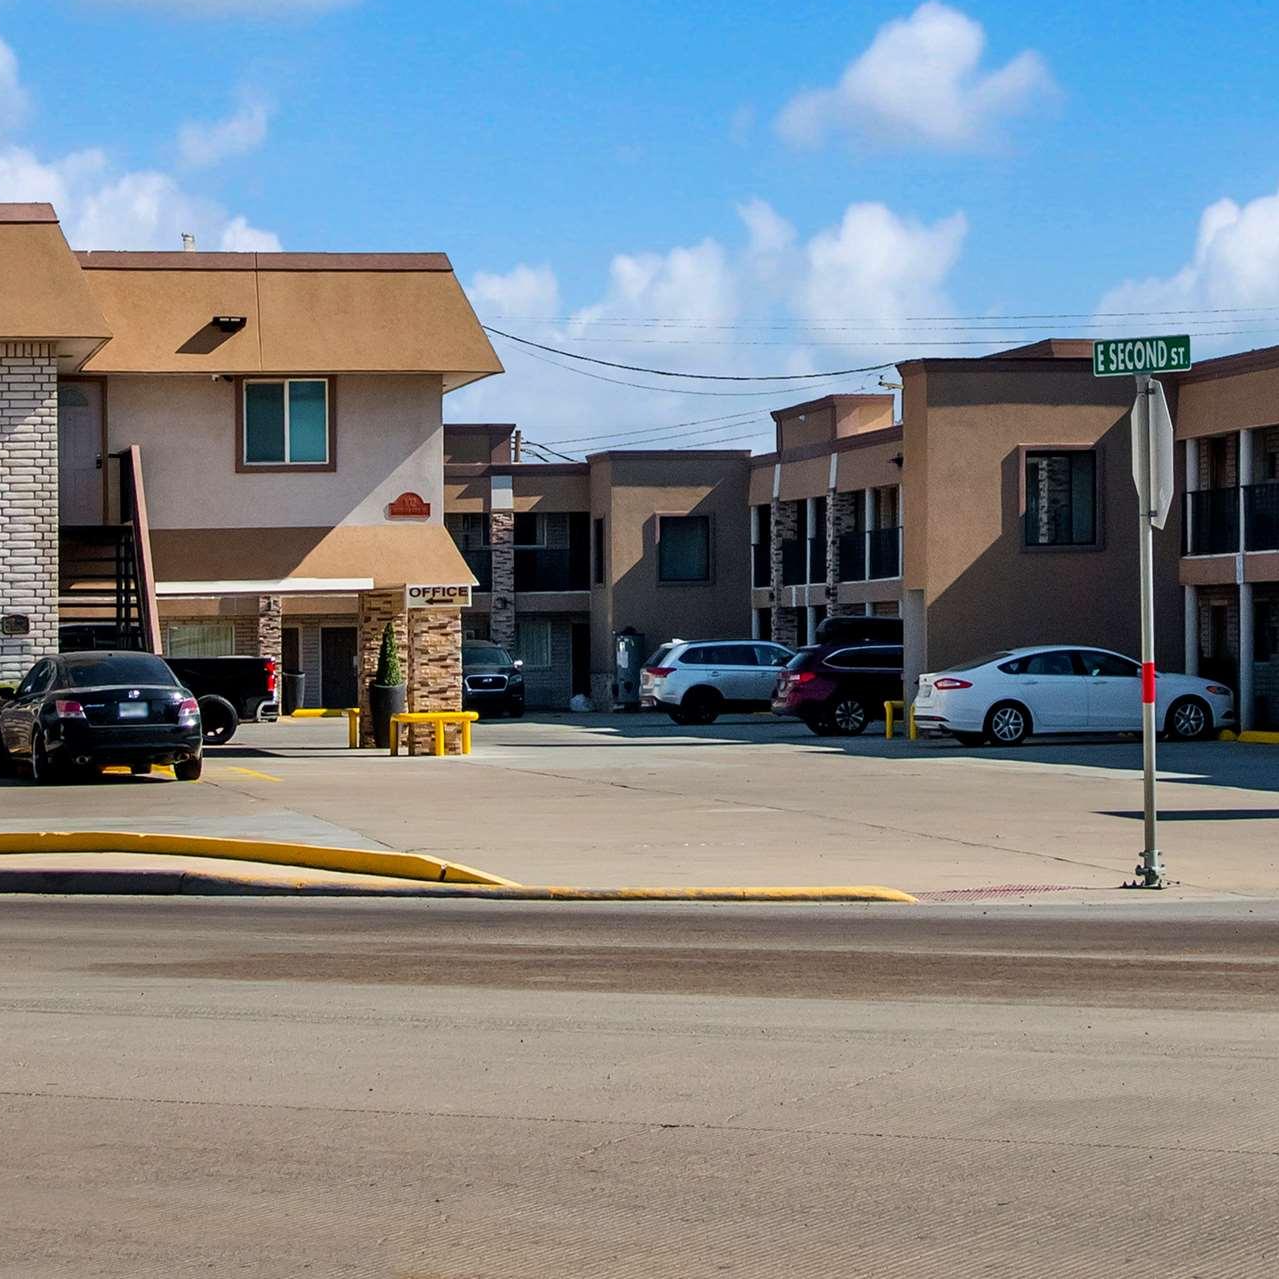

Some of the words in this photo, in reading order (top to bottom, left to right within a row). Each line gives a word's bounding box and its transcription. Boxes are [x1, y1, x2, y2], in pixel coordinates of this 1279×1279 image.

[1097, 344, 1105, 371] E
[1109, 340, 1167, 371] SECOND
[409, 586, 469, 598] OFFICE
